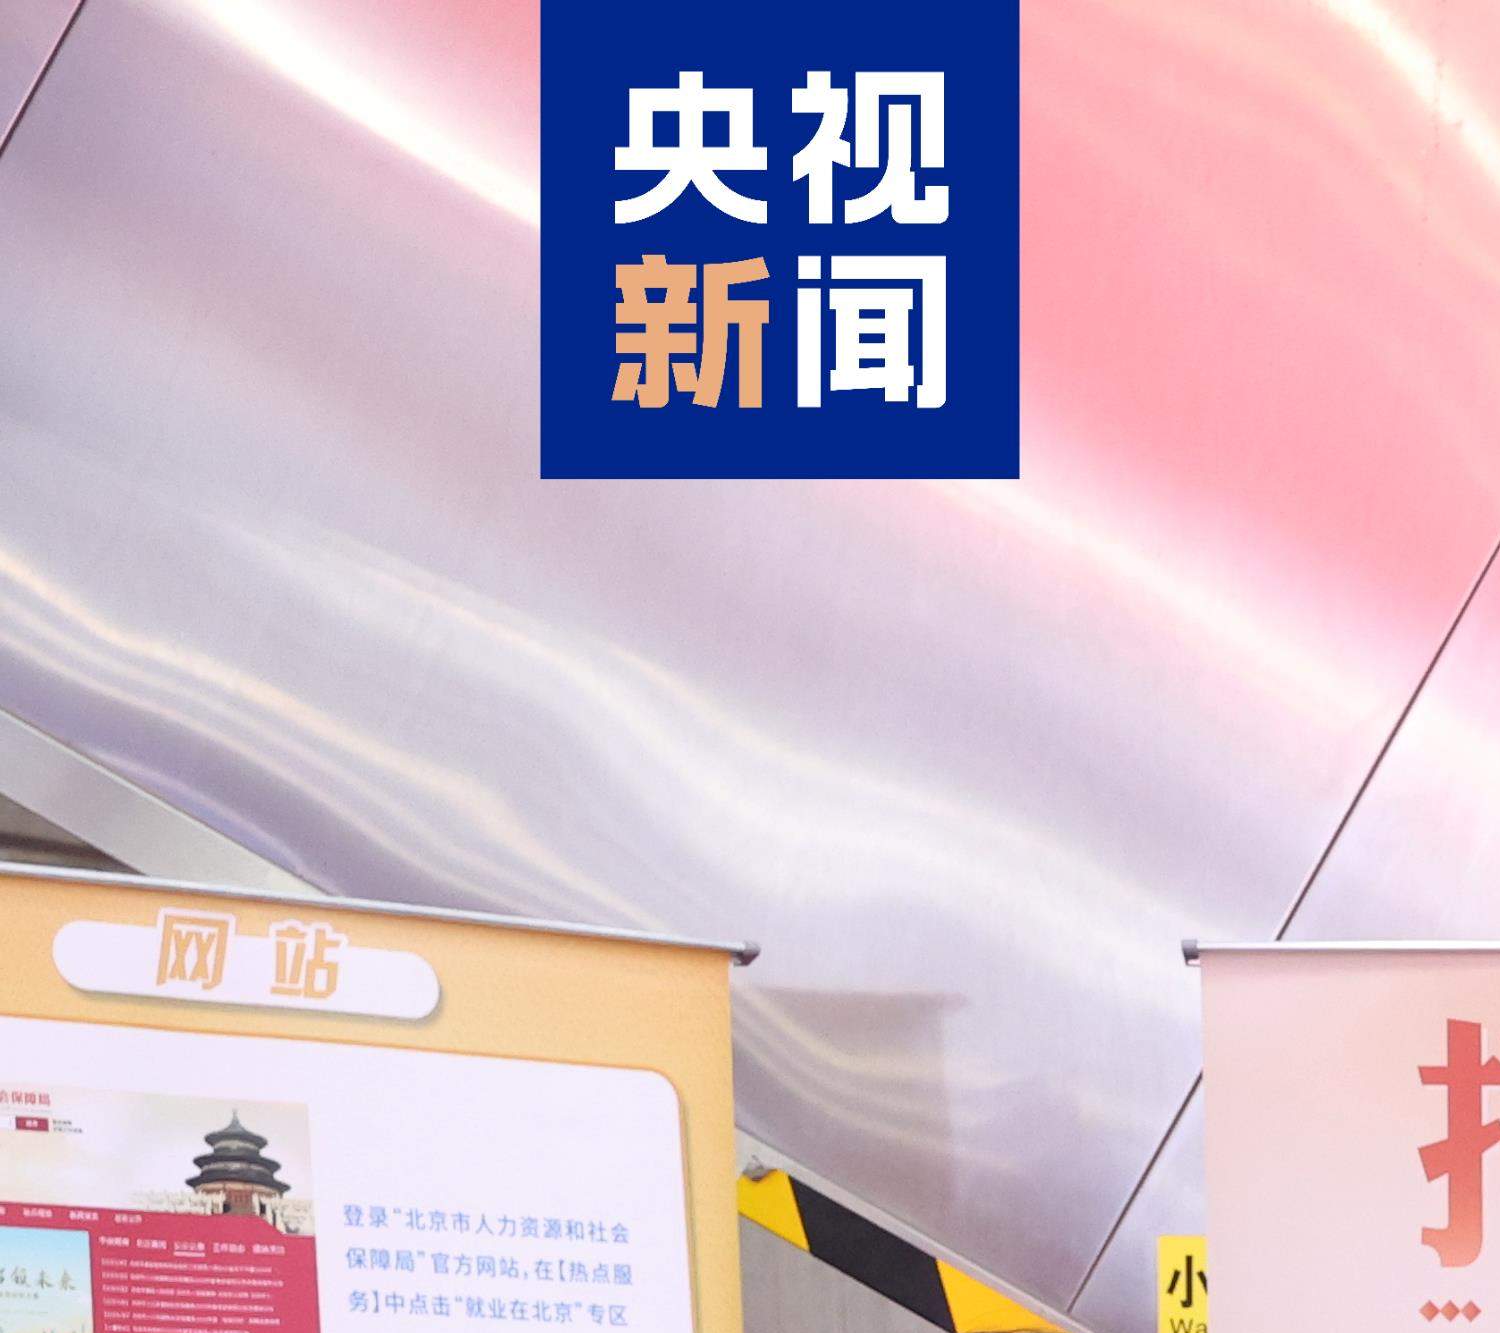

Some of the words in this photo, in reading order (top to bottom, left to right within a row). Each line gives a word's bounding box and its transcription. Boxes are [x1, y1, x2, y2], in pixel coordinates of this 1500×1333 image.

[156, 914, 340, 999] 网站
[343, 1204, 631, 1245] 登录“北京市人力资源和社会
